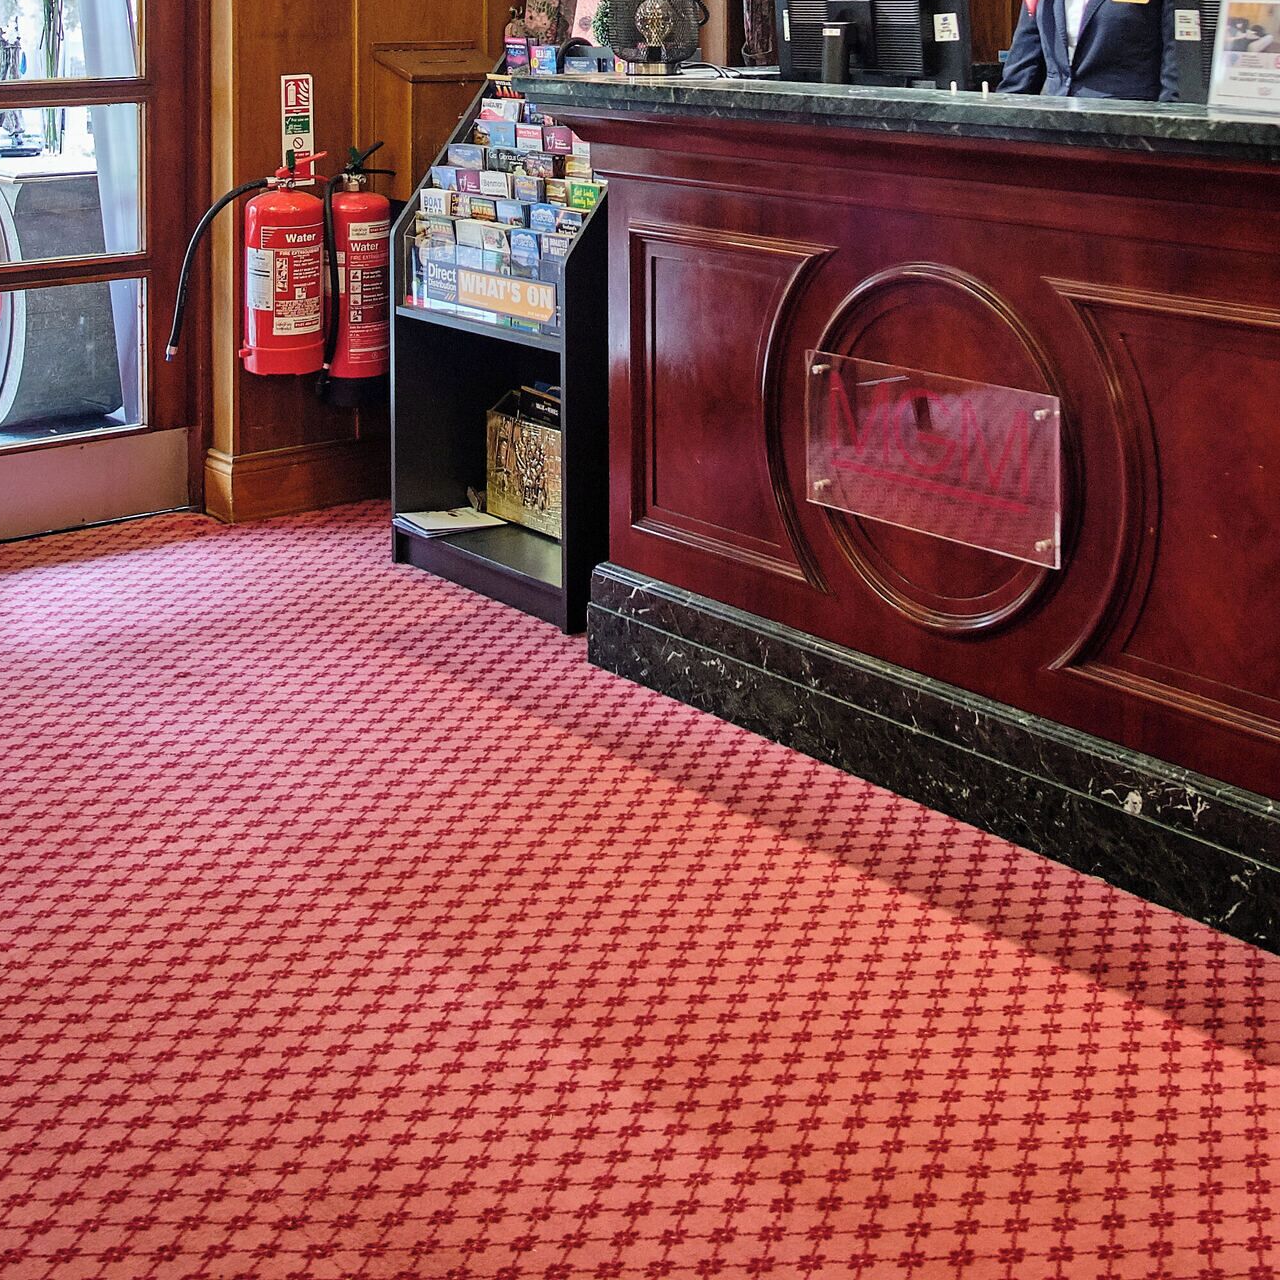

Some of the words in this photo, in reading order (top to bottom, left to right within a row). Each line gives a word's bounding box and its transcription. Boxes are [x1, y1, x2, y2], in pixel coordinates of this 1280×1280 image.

[423, 195, 443, 209] BOAT
[284, 233, 317, 243] Water
[350, 242, 379, 252] Water
[428, 261, 457, 283] Direct
[428, 279, 457, 292] Distribution
[460, 270, 522, 304] WHAT'S
[526, 285, 554, 310] ON
[827, 370, 1031, 498] MGM
